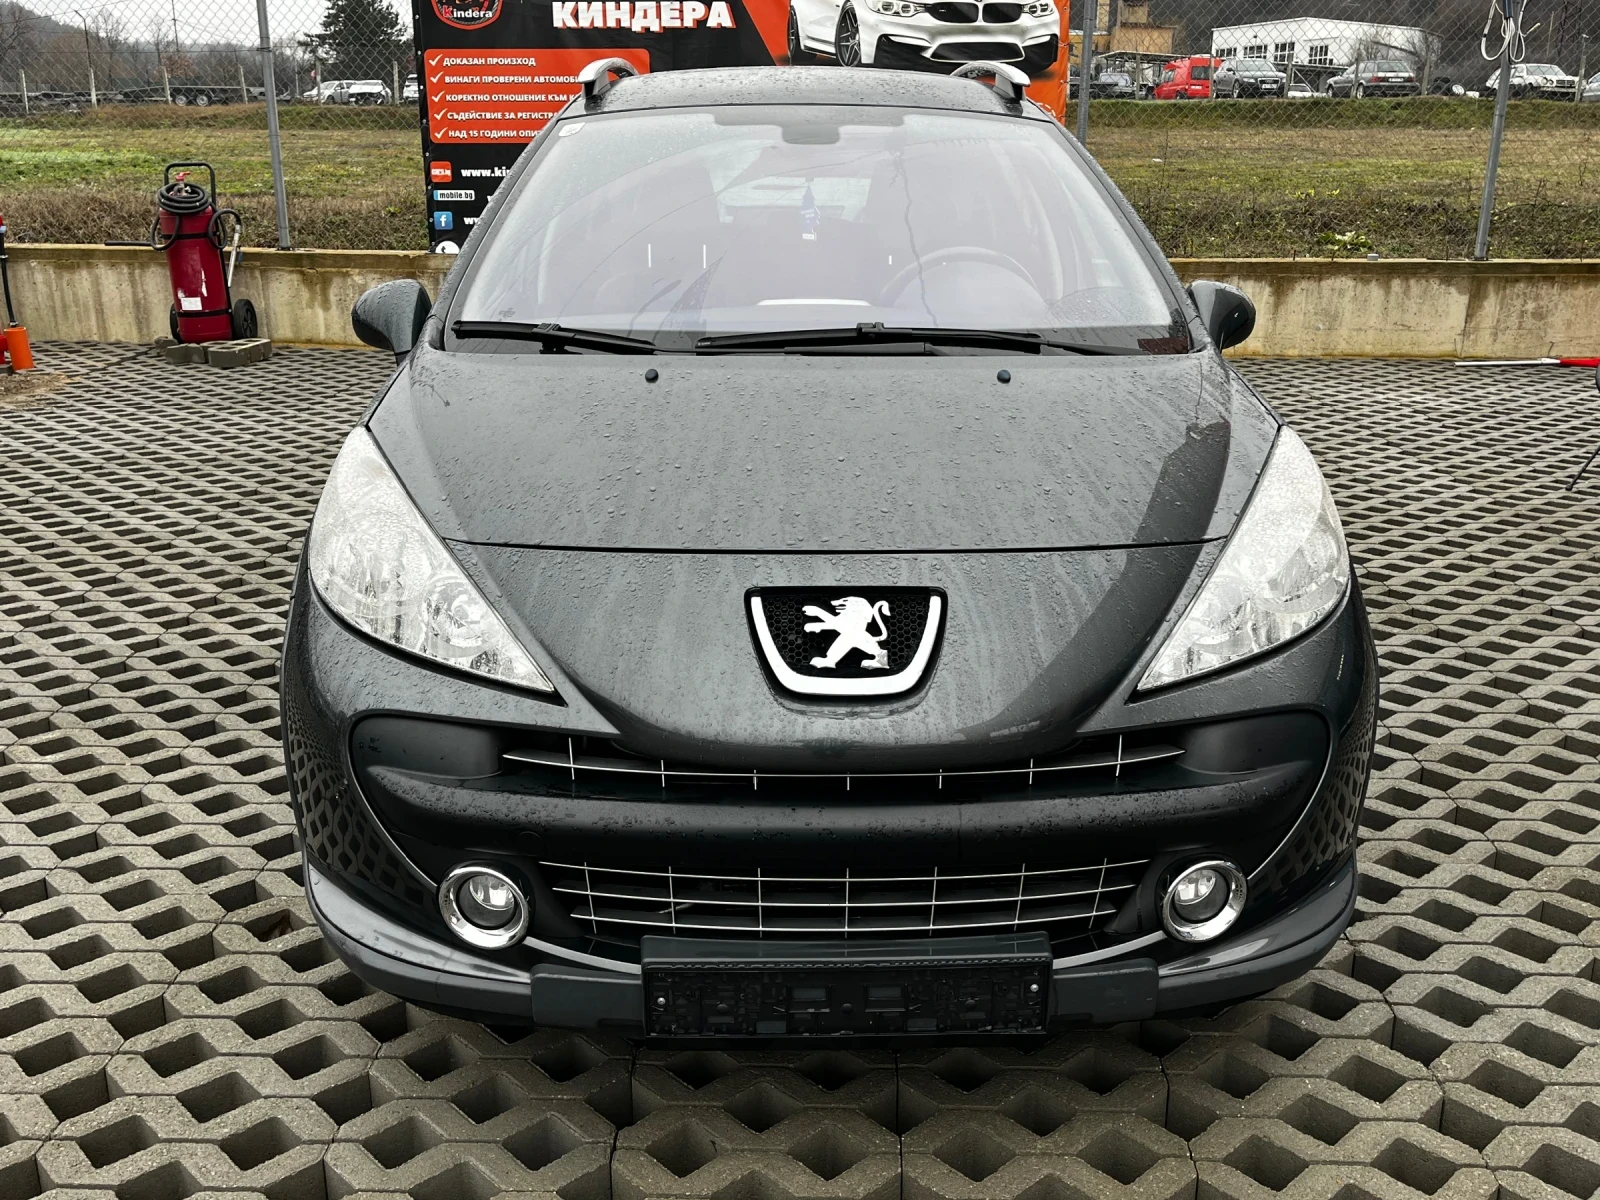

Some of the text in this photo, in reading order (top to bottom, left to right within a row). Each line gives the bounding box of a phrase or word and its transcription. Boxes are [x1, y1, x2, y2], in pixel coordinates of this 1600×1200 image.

[442, 5, 493, 18] Kindera
[552, 1, 736, 33] КИНДЕРА
[443, 57, 536, 66] ДОКАЗАН ПРОИЗХОД
[447, 110, 502, 120] СЪДЕЙСТВИЕ
[448, 130, 467, 138] НАД
[480, 130, 517, 138] ГОДИНИ
[439, 191, 473, 199] mobile.bg
